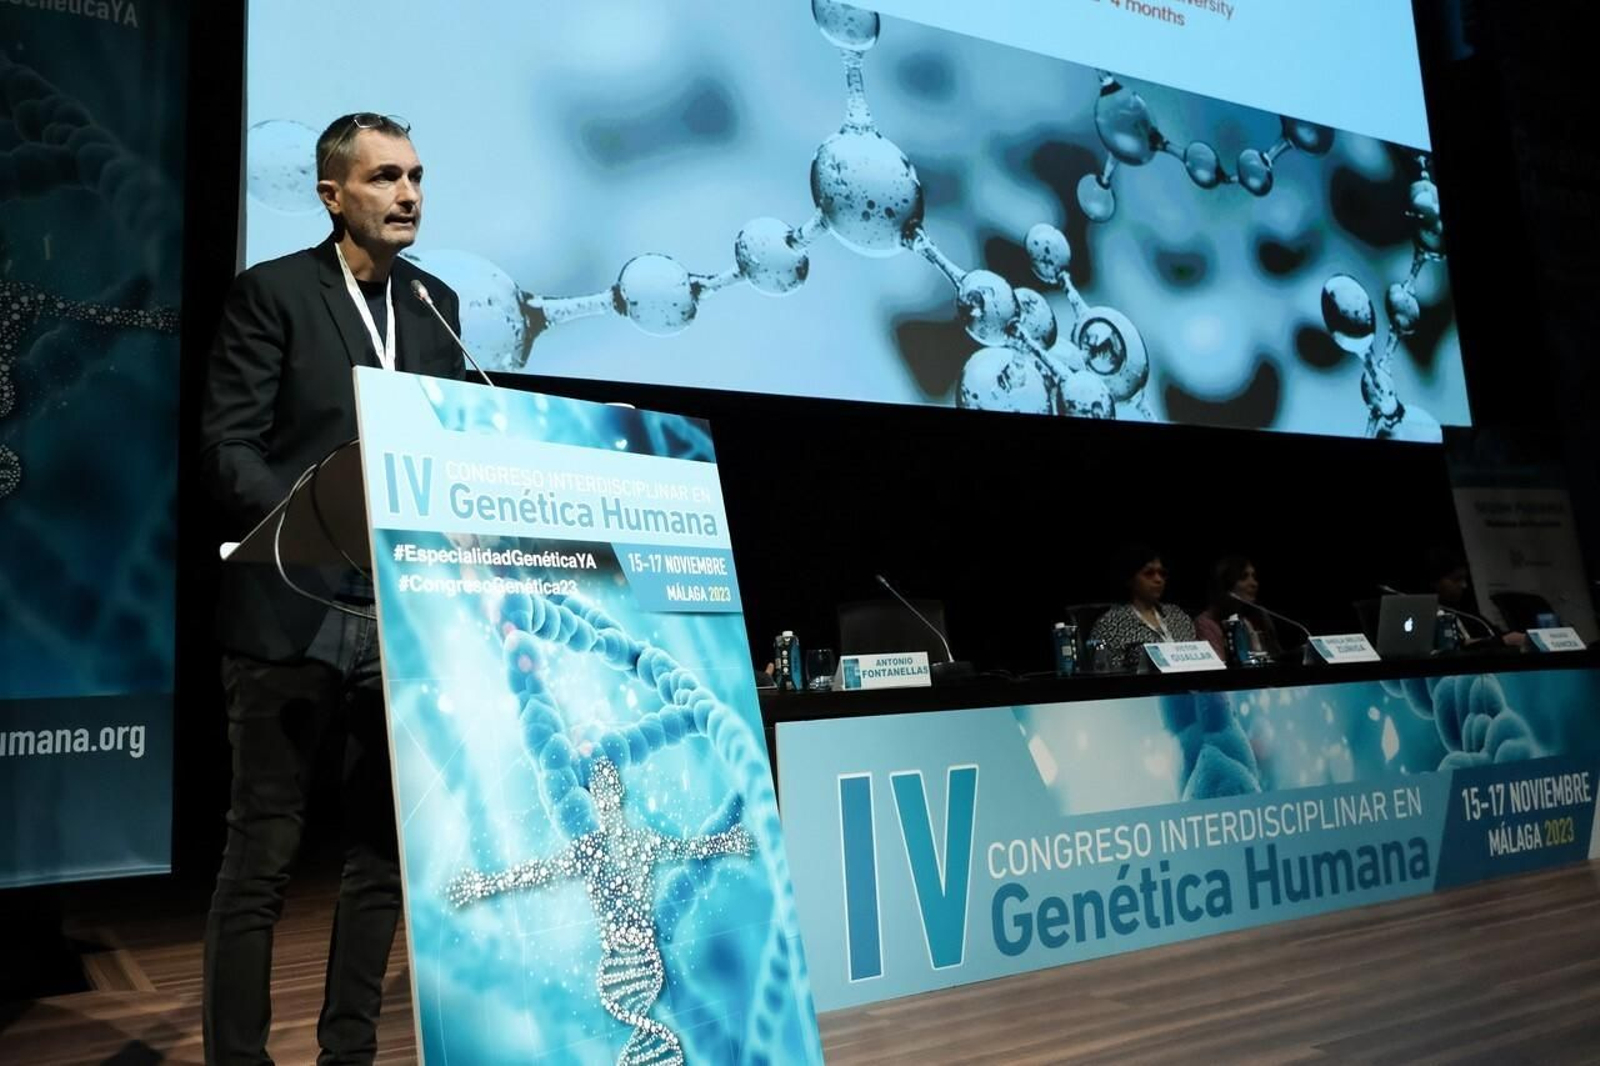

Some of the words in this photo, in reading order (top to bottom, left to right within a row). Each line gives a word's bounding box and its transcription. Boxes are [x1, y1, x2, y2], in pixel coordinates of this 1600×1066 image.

[1125, 0, 1185, 26] months
[384, 452, 433, 517] IV
[445, 461, 544, 488] CONGRESO
[549, 472, 688, 500] INTERDISCIPLINAR
[692, 486, 711, 503] EN
[450, 482, 594, 528] Genética
[601, 496, 718, 536] Humana
[394, 544, 597, 569] #EspecialidadGenéticaYA
[628, 553, 662, 573] 15-17
[664, 554, 728, 576] NOVIEMBRE
[399, 575, 579, 597] #CongresoGenética23
[666, 581, 708, 601] MÁLAGA
[709, 585, 731, 602] 2023
[861, 666, 929, 679] FONTANELLAS
[875, 657, 914, 667] ANTONIO
[1462, 782, 1505, 821] 15-17
[1511, 771, 1592, 814] NOVIEMBRE
[988, 823, 1152, 879] CONGRESO
[1160, 793, 1388, 853] INTERDISCIPLINAR
[1394, 787, 1423, 819] EN
[1488, 821, 1543, 857] MÁLAGA
[1545, 816, 1575, 847] 2023
[837, 764, 979, 983] IV
[991, 860, 1233, 957] Genética
[1244, 836, 1431, 910] Humana
